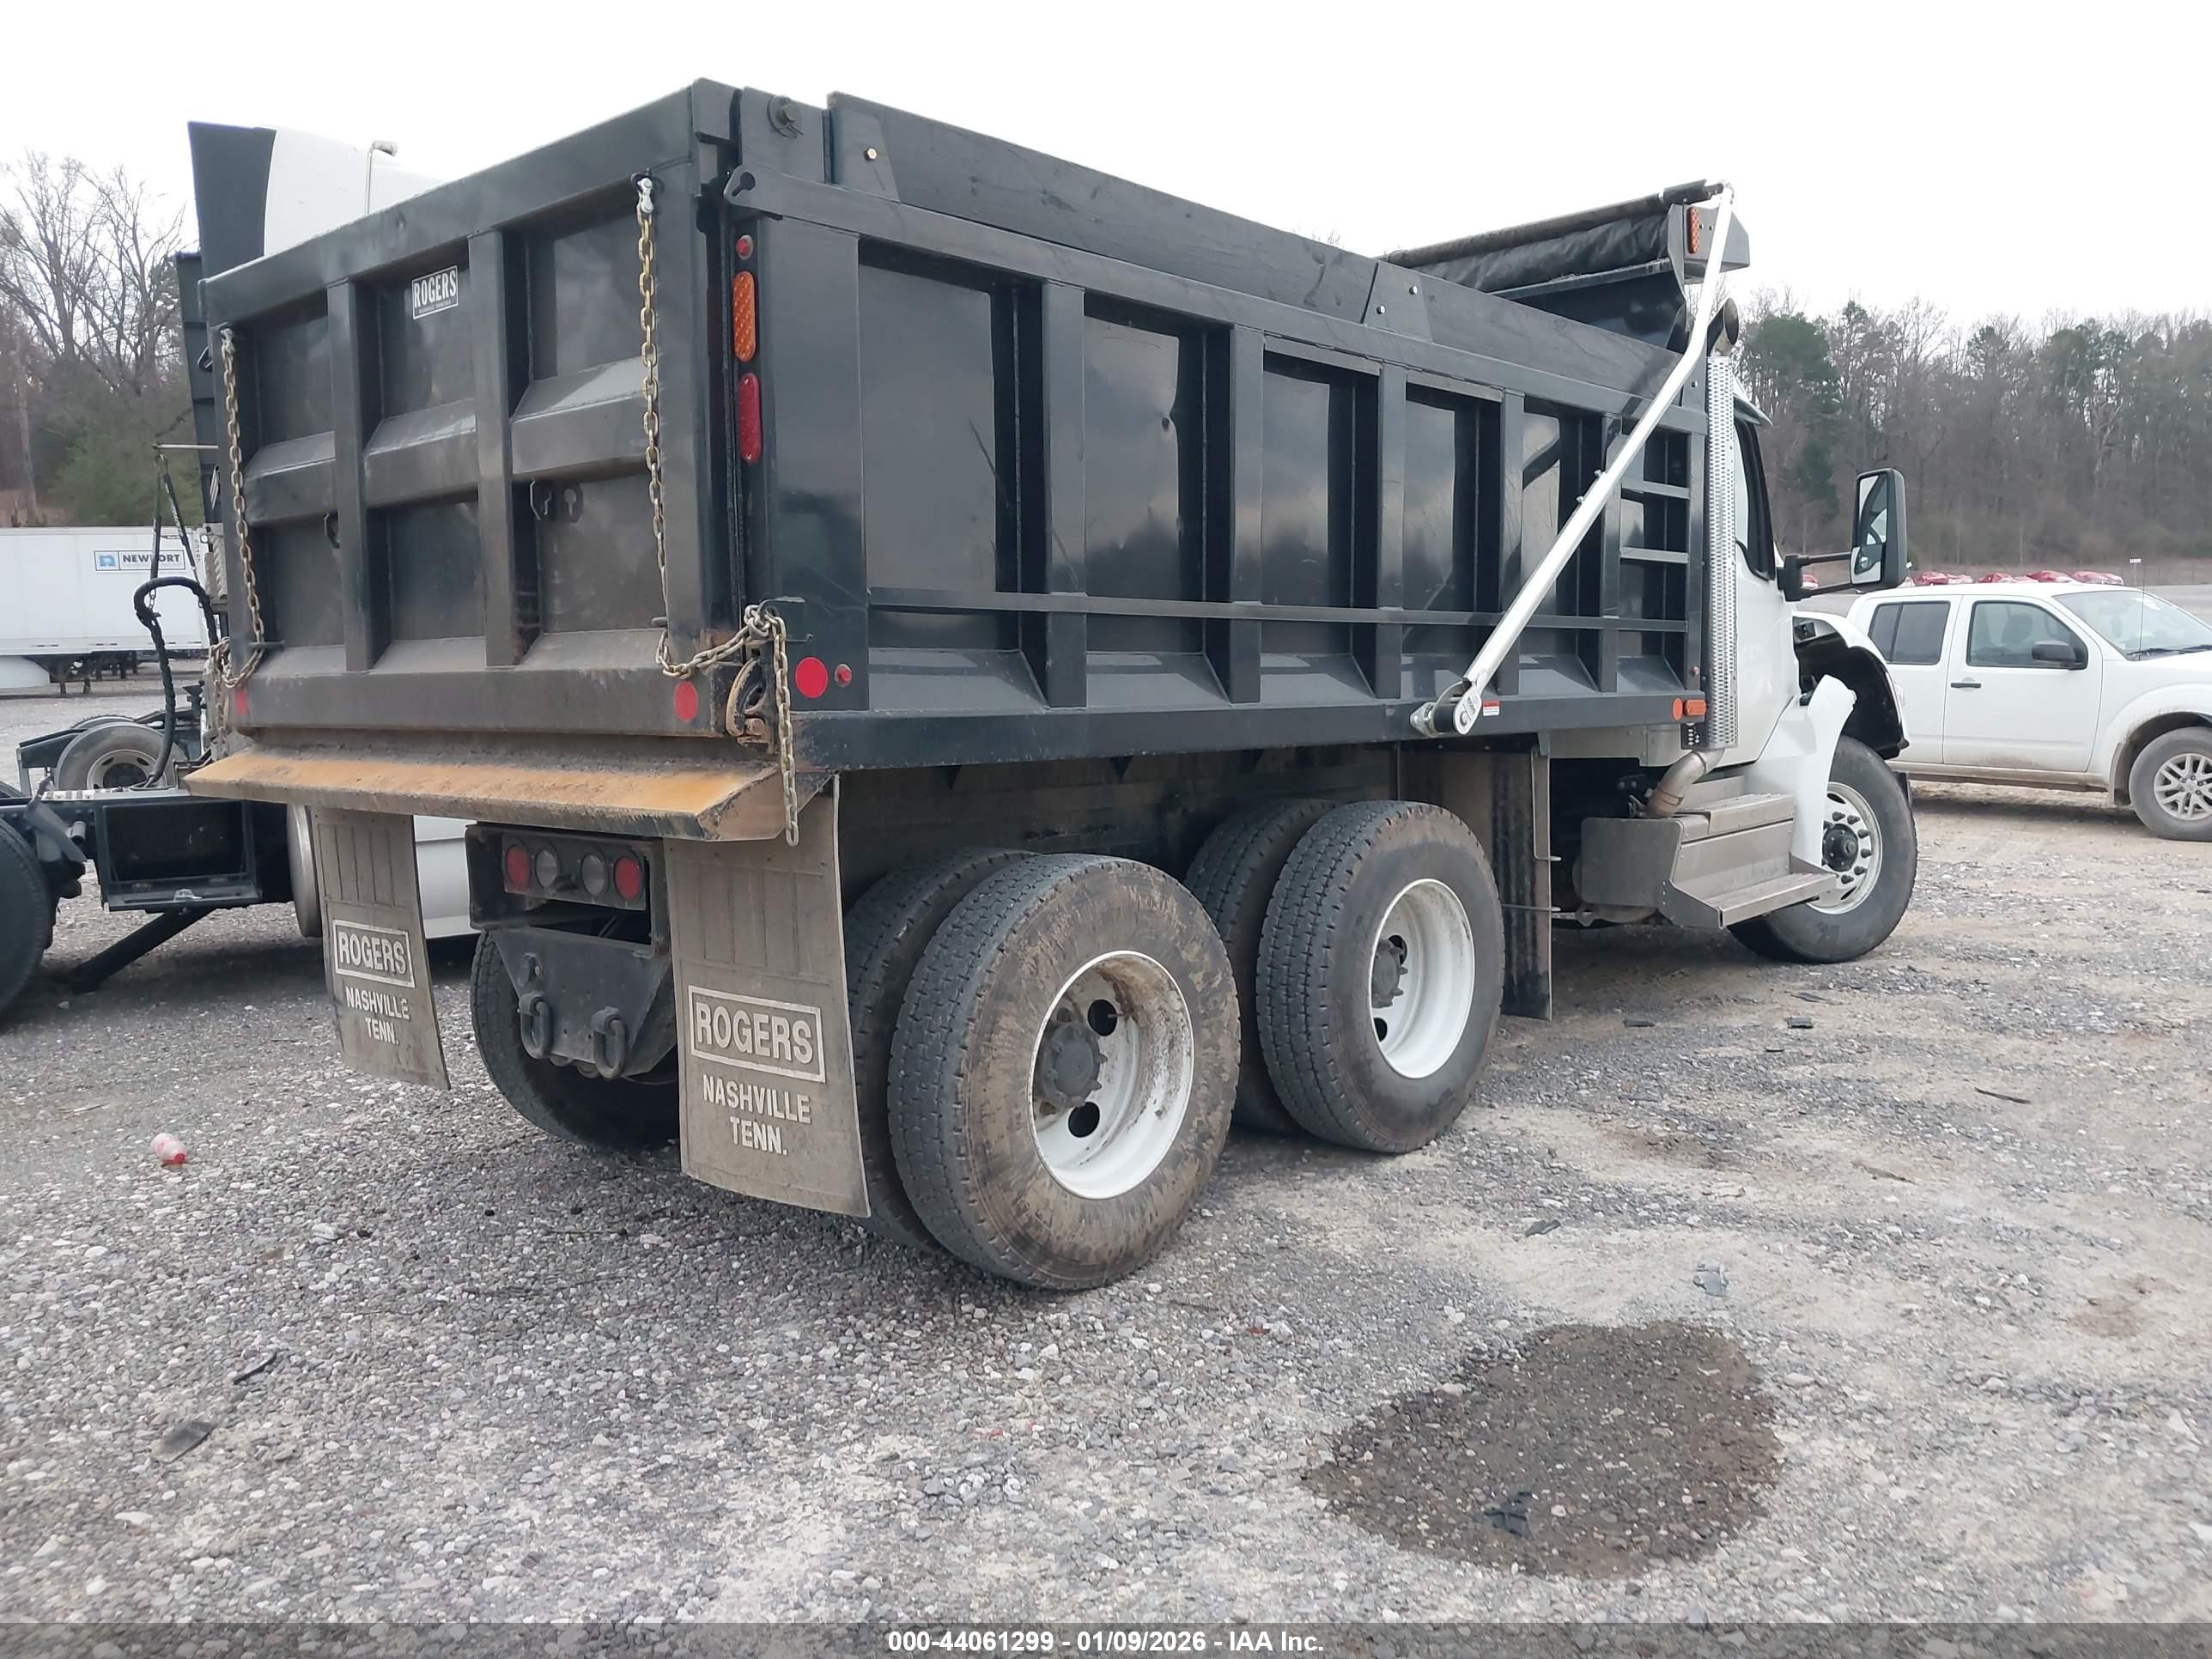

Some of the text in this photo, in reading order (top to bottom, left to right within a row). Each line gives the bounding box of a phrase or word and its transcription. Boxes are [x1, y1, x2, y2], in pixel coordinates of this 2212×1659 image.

[414, 270, 456, 308] ROGERS
[123, 554, 180, 563] NEWORT
[338, 931, 406, 974] ROGERS
[345, 987, 410, 1020] NASHVILLE
[365, 1017, 399, 1045] TENN.
[696, 1001, 813, 1064] ROGERS
[702, 1074, 811, 1124] NASHVILLE
[730, 1116, 787, 1156] TENN.
